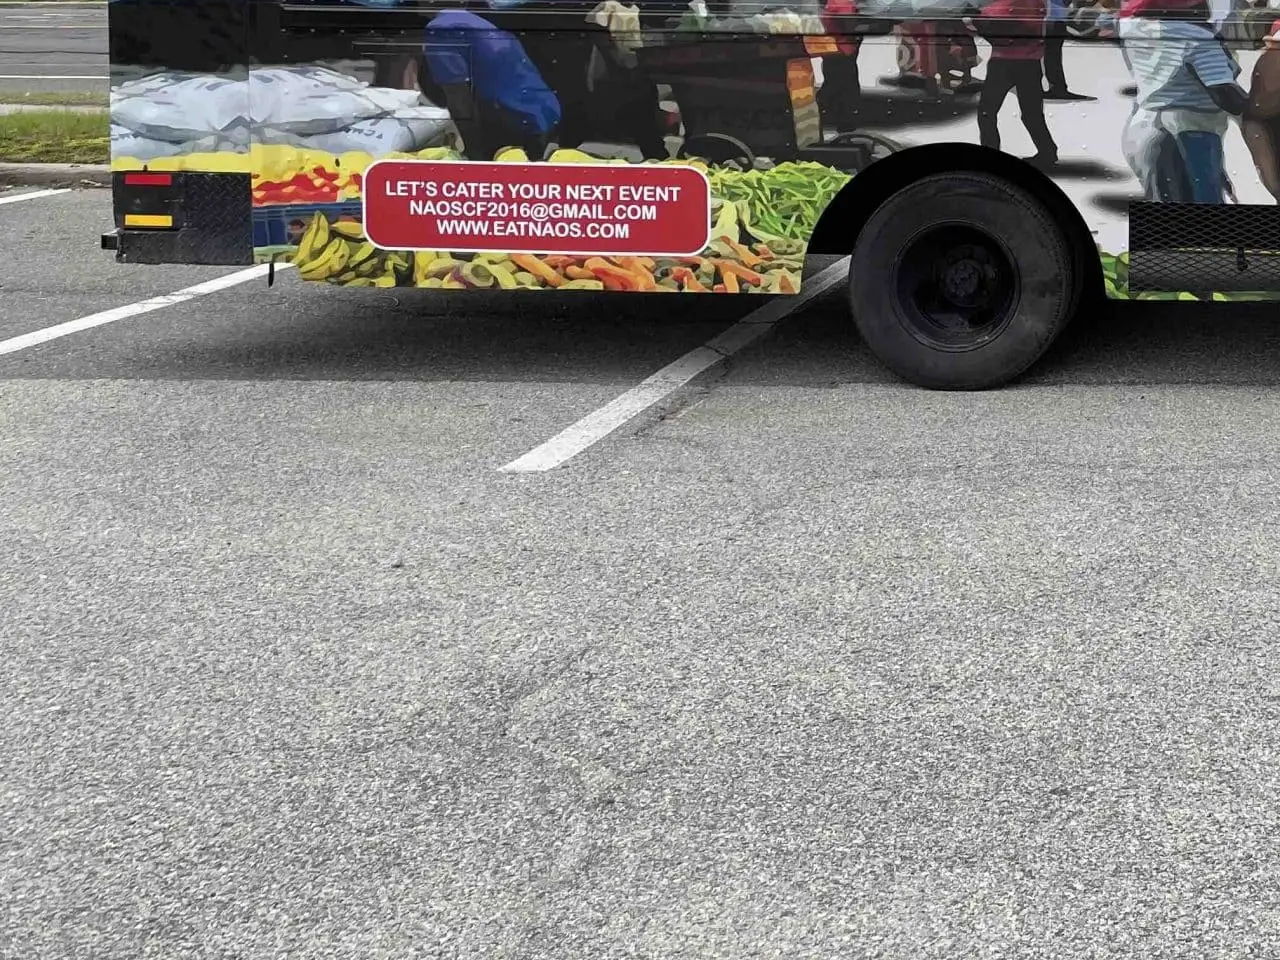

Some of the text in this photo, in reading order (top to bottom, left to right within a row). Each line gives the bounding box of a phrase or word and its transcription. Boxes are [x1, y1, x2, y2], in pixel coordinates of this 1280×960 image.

[385, 181, 681, 202] LET'S CATER YOUR NEXT EVENT
[409, 200, 656, 221] NAOSCF2016@GMAIL.COM
[436, 219, 630, 238] WWW.EATNAOS.COM
